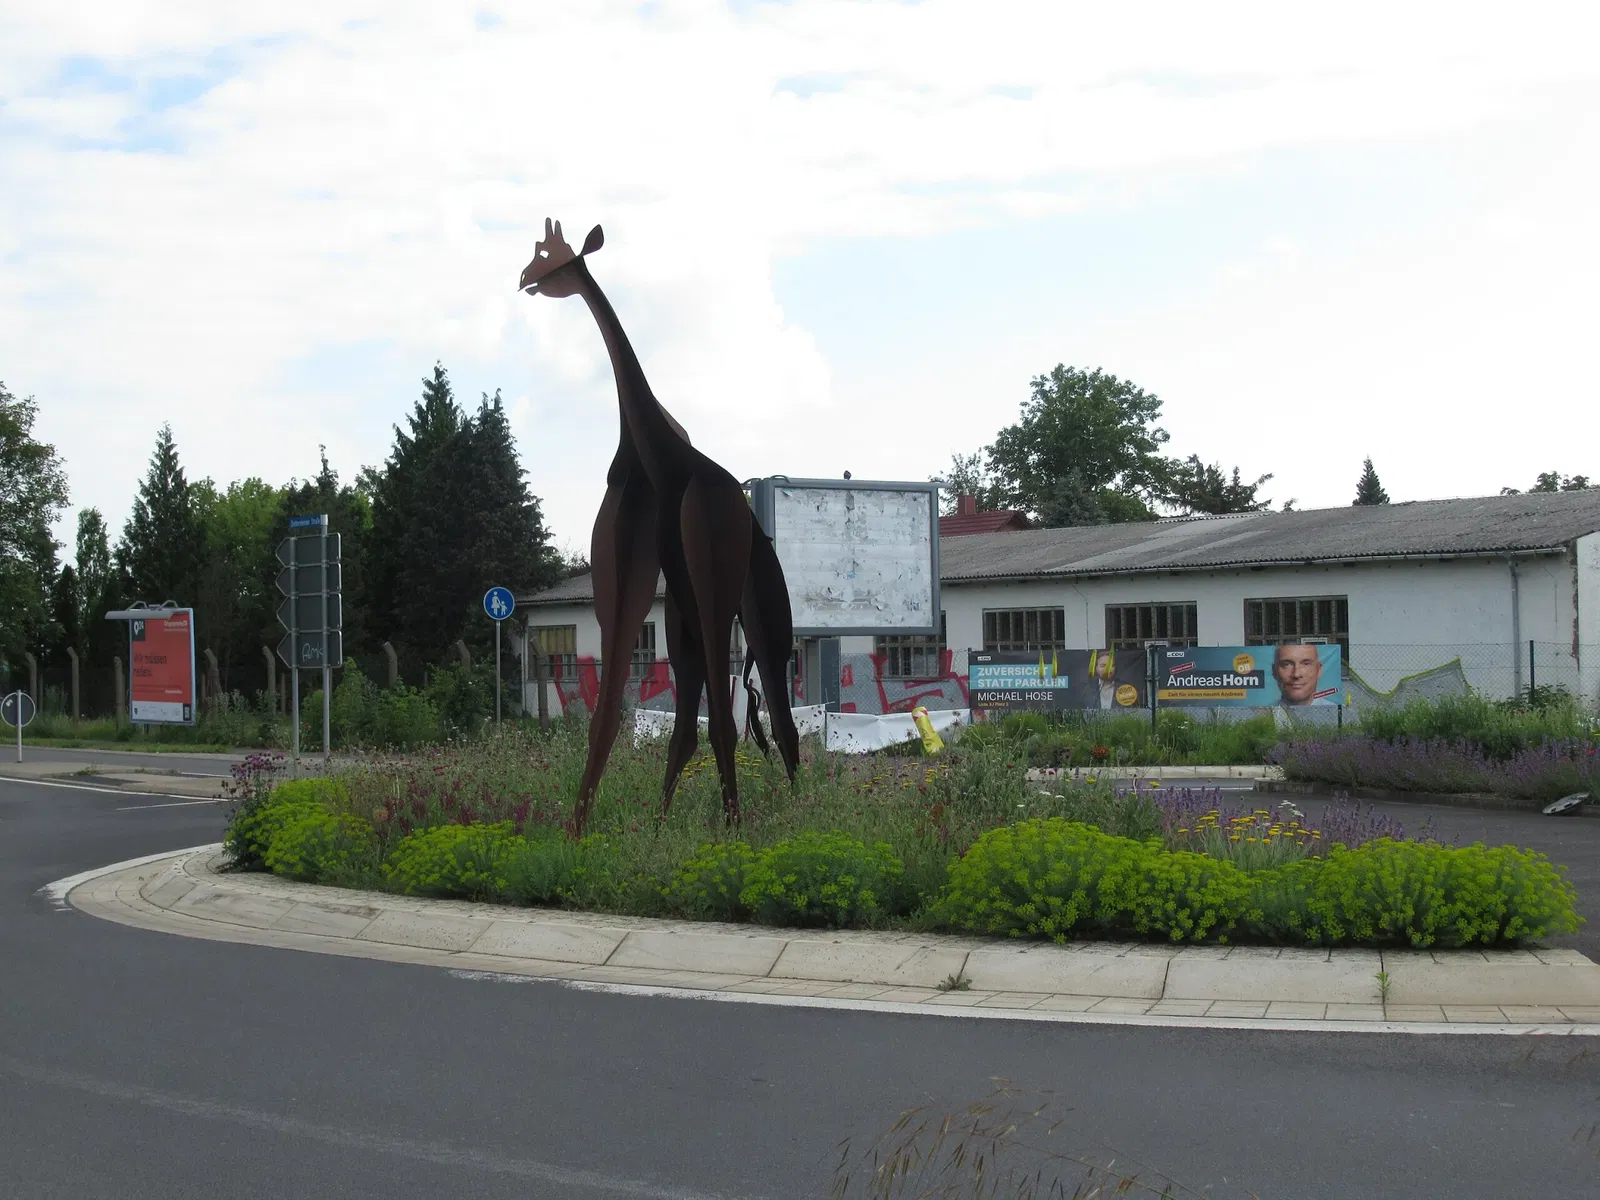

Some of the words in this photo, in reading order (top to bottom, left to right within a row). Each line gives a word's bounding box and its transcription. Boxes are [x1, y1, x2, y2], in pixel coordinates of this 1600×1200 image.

[978, 667, 1048, 676] ZUVERSICHT
[1238, 664, 1250, 672] OB
[978, 678, 1014, 688] STATT
[1016, 678, 1066, 688] PAROLEN
[1167, 675, 1221, 687] Andreas
[1223, 674, 1259, 686] Horn
[978, 692, 1022, 701] MICHAEL
[1025, 691, 1053, 701] HOSE
